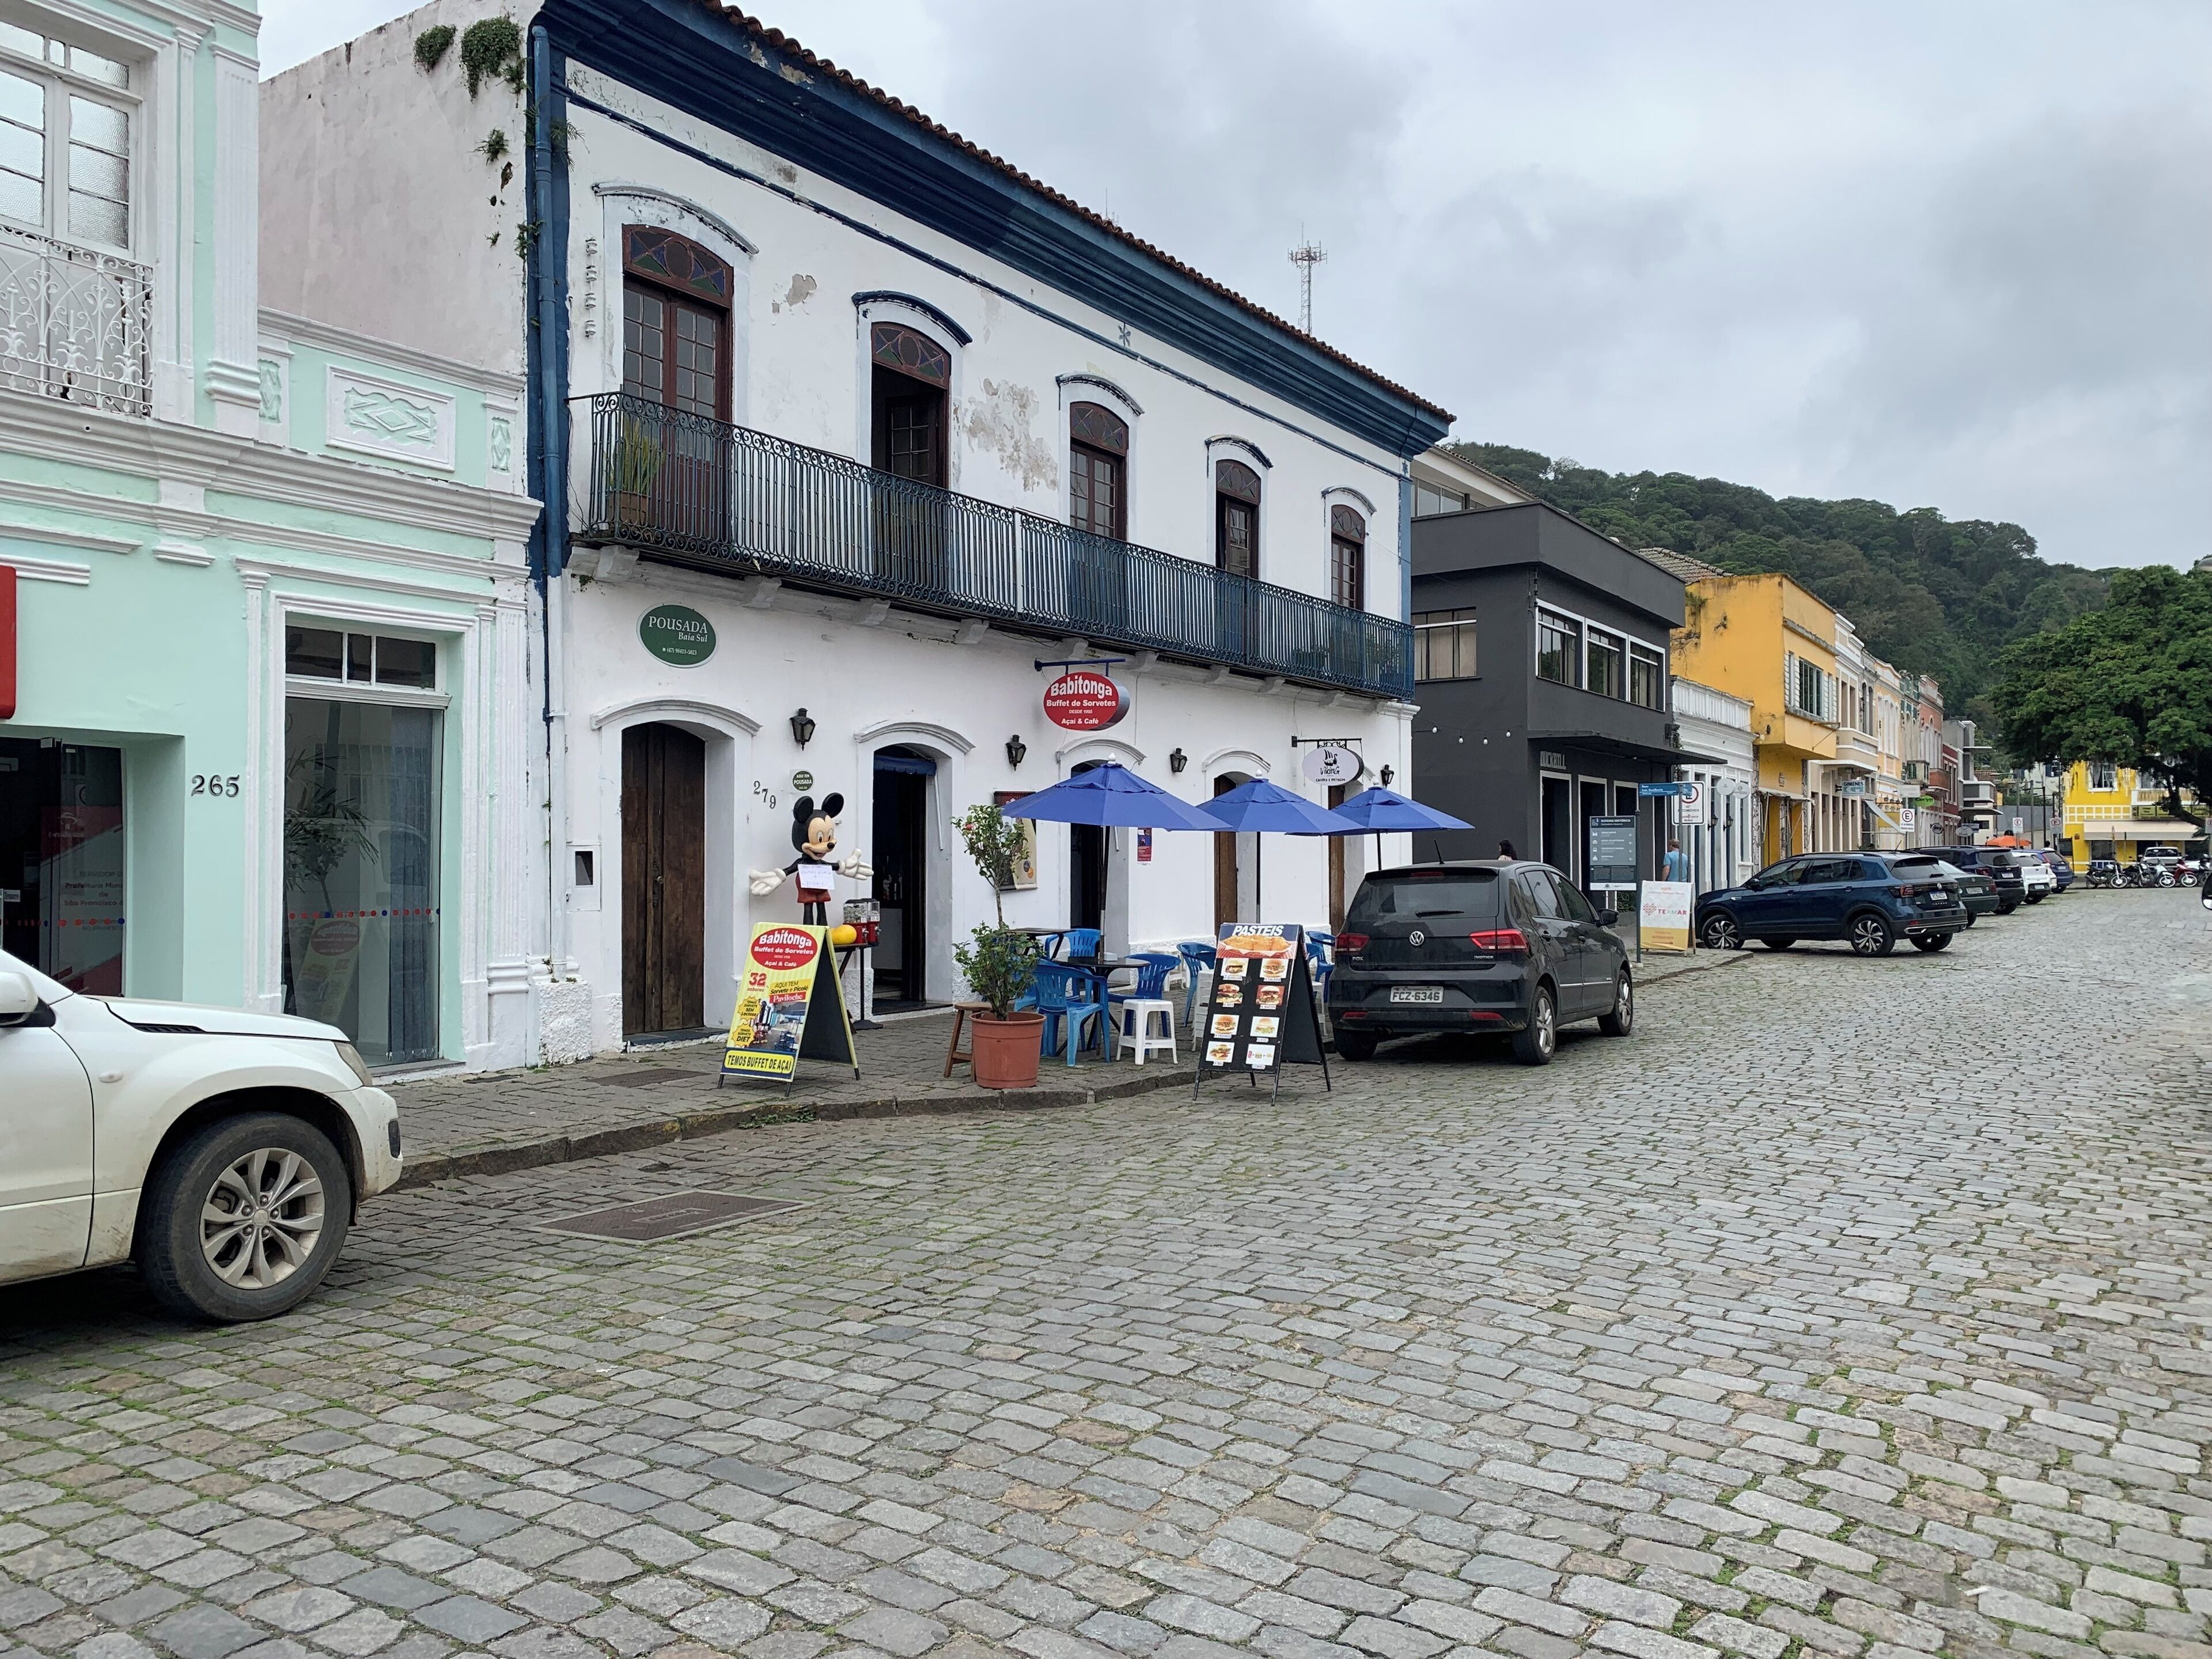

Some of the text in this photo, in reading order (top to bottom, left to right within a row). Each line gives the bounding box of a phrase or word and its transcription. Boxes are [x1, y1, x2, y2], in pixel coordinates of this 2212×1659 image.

[649, 616, 708, 634] POUSADA
[696, 634, 708, 642] Sul
[1051, 675, 1112, 699] Babitonga
[191, 774, 240, 798] 265
[753, 780, 776, 809] 279
[1232, 925, 1284, 937] PASTEIS
[759, 930, 812, 949] Babitonga
[749, 972, 767, 986] 32
[773, 993, 803, 1002] Paviloche
[727, 1055, 747, 1066] TEMOS
[747, 1056, 769, 1069] BUFFET
[769, 1059, 778, 1069] DE
